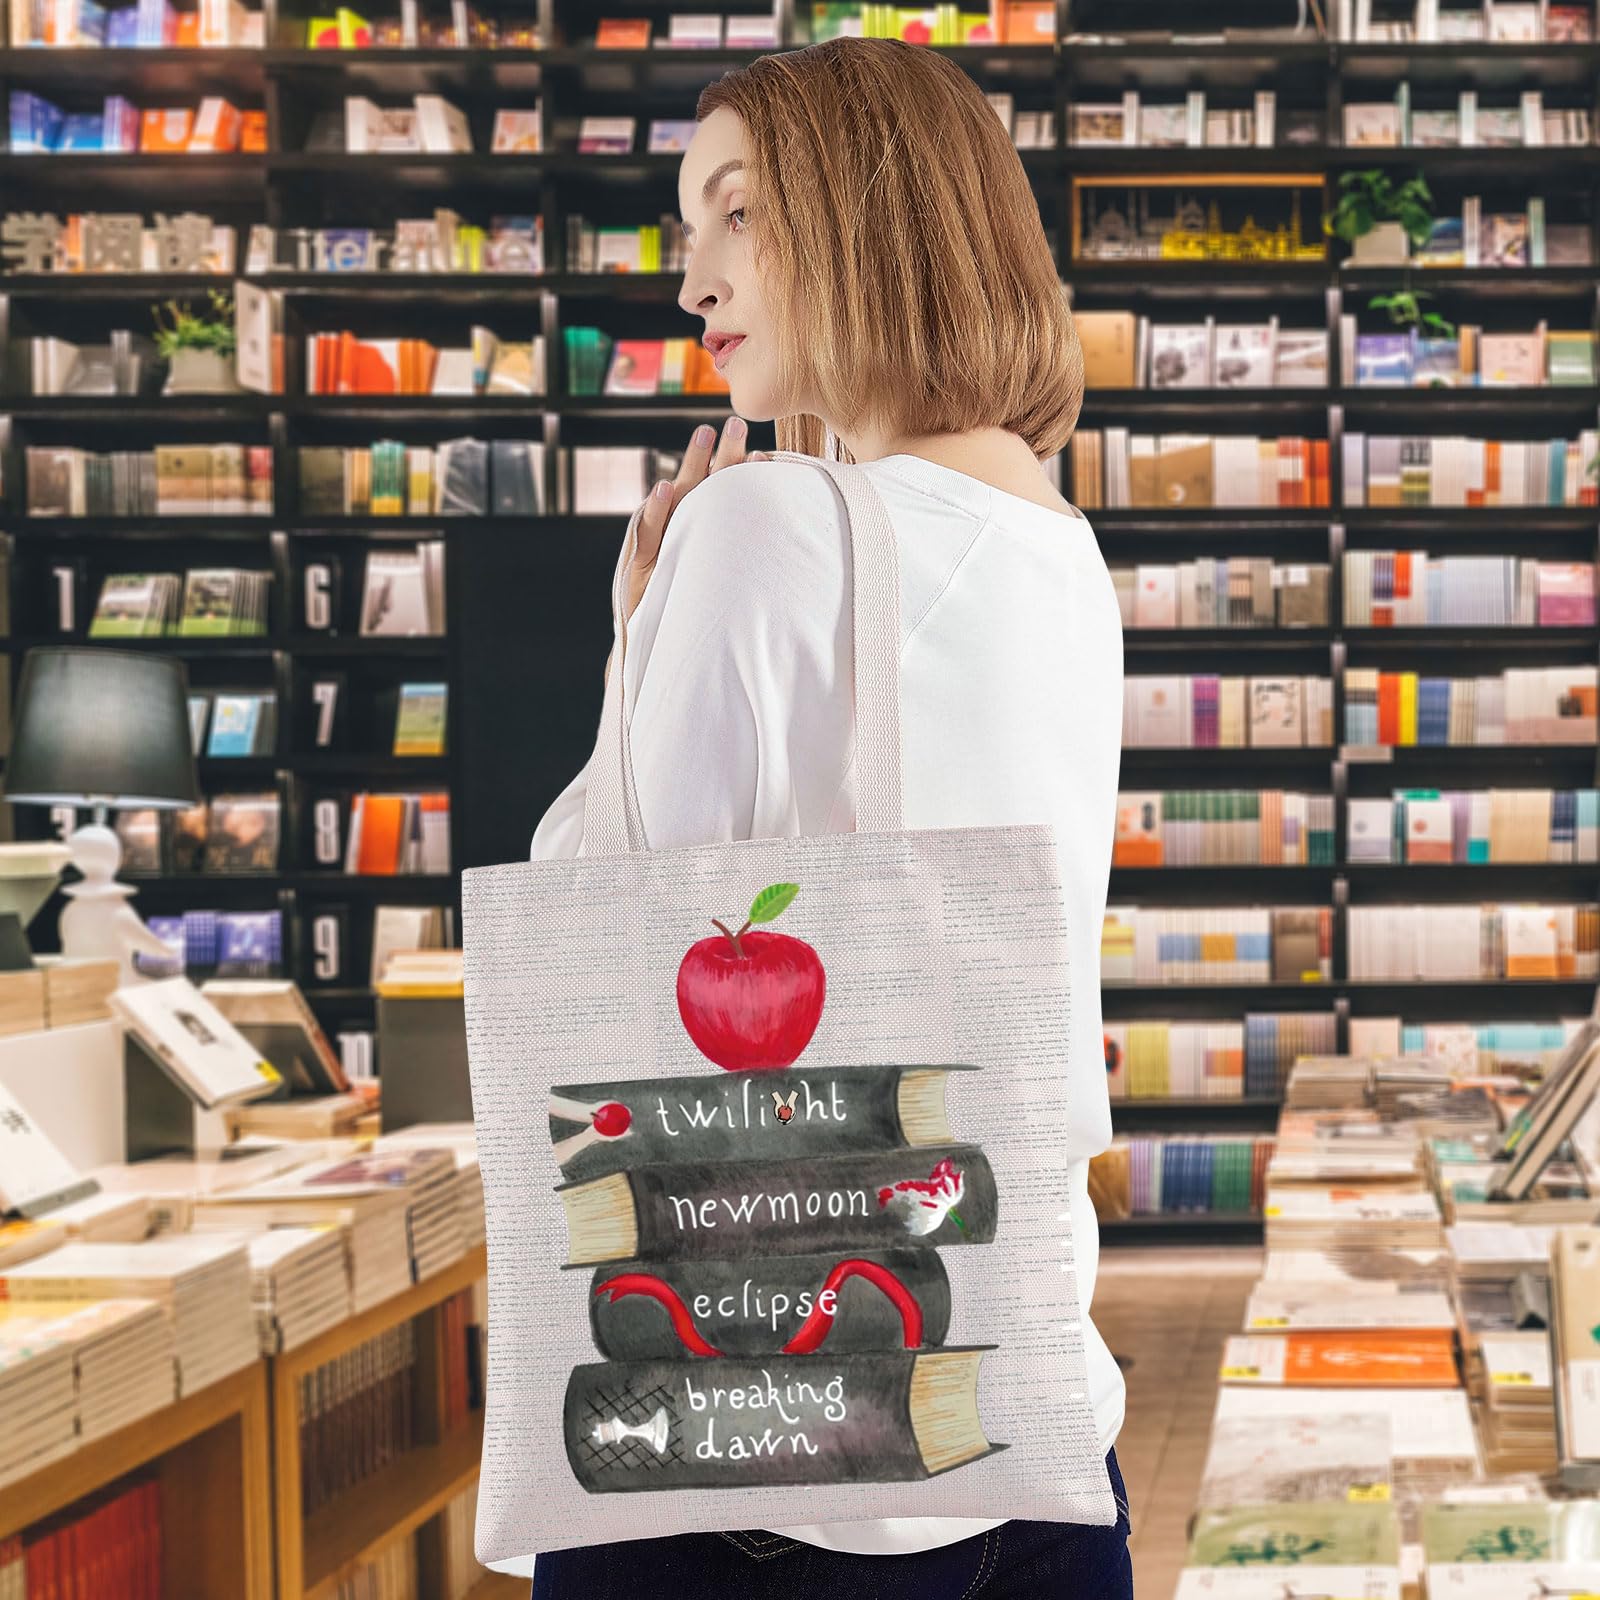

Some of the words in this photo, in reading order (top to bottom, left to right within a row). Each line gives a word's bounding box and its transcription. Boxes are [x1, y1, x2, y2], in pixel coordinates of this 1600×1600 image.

[52, 567, 74, 631] 1
[305, 564, 330, 629] 6
[313, 682, 338, 746] 7
[314, 801, 340, 864] 8
[314, 916, 340, 980] 9
[656, 1079, 847, 1137] twiliht
[693, 1279, 838, 1332] eclipse
[685, 1369, 847, 1424] breaking
[695, 1418, 819, 1460] dawn
